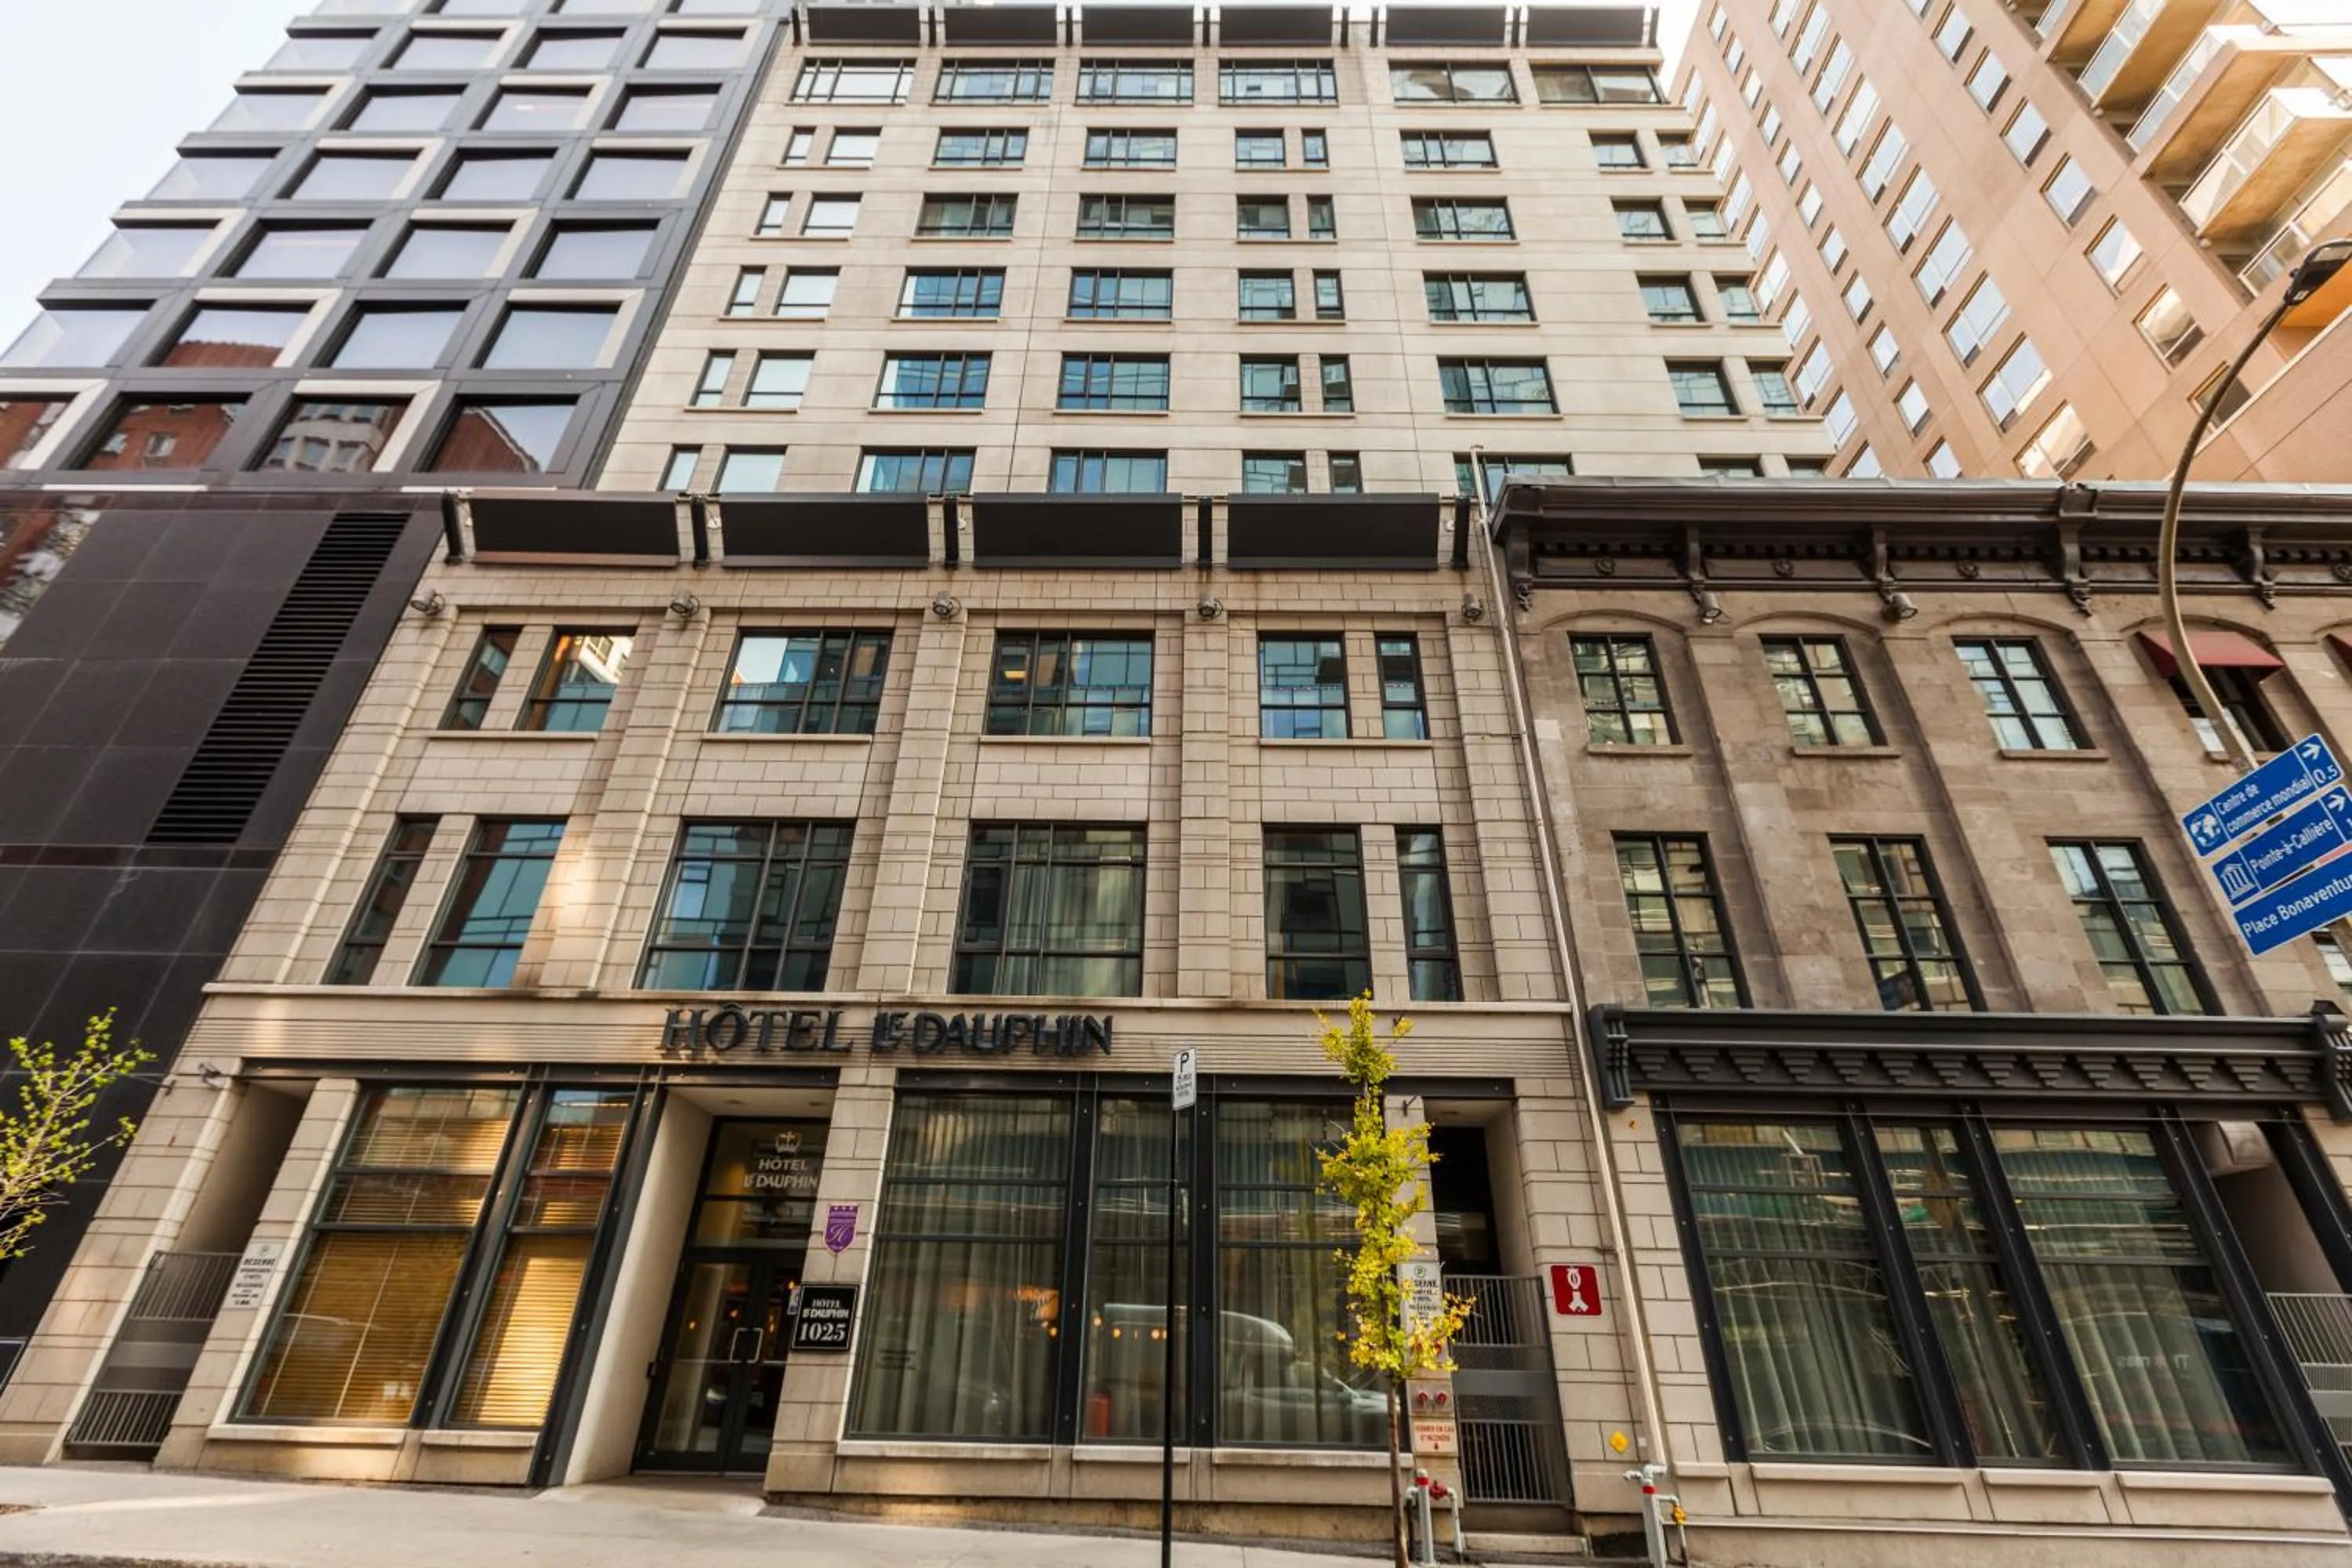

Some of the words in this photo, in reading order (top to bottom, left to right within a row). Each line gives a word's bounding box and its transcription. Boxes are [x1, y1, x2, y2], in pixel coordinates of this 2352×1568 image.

[2313, 764, 2339, 784] 0.5
[2216, 791, 2247, 815] Centre
[2245, 783, 2259, 798] de
[2227, 799, 2274, 833] commerce
[2270, 772, 2312, 807] mondial
[2249, 819, 2334, 875] Pointe-à-Callière
[2242, 913, 2279, 938] Place
[2277, 873, 2352, 920] Bonaventu
[661, 1001, 854, 1053] HÔTEL
[870, 1011, 909, 1054] LE
[912, 1011, 1113, 1056] DAUPHIN
[1181, 1052, 1189, 1073] P
[756, 1174, 818, 1189] DAUPHIN
[800, 1322, 847, 1341] 1025
